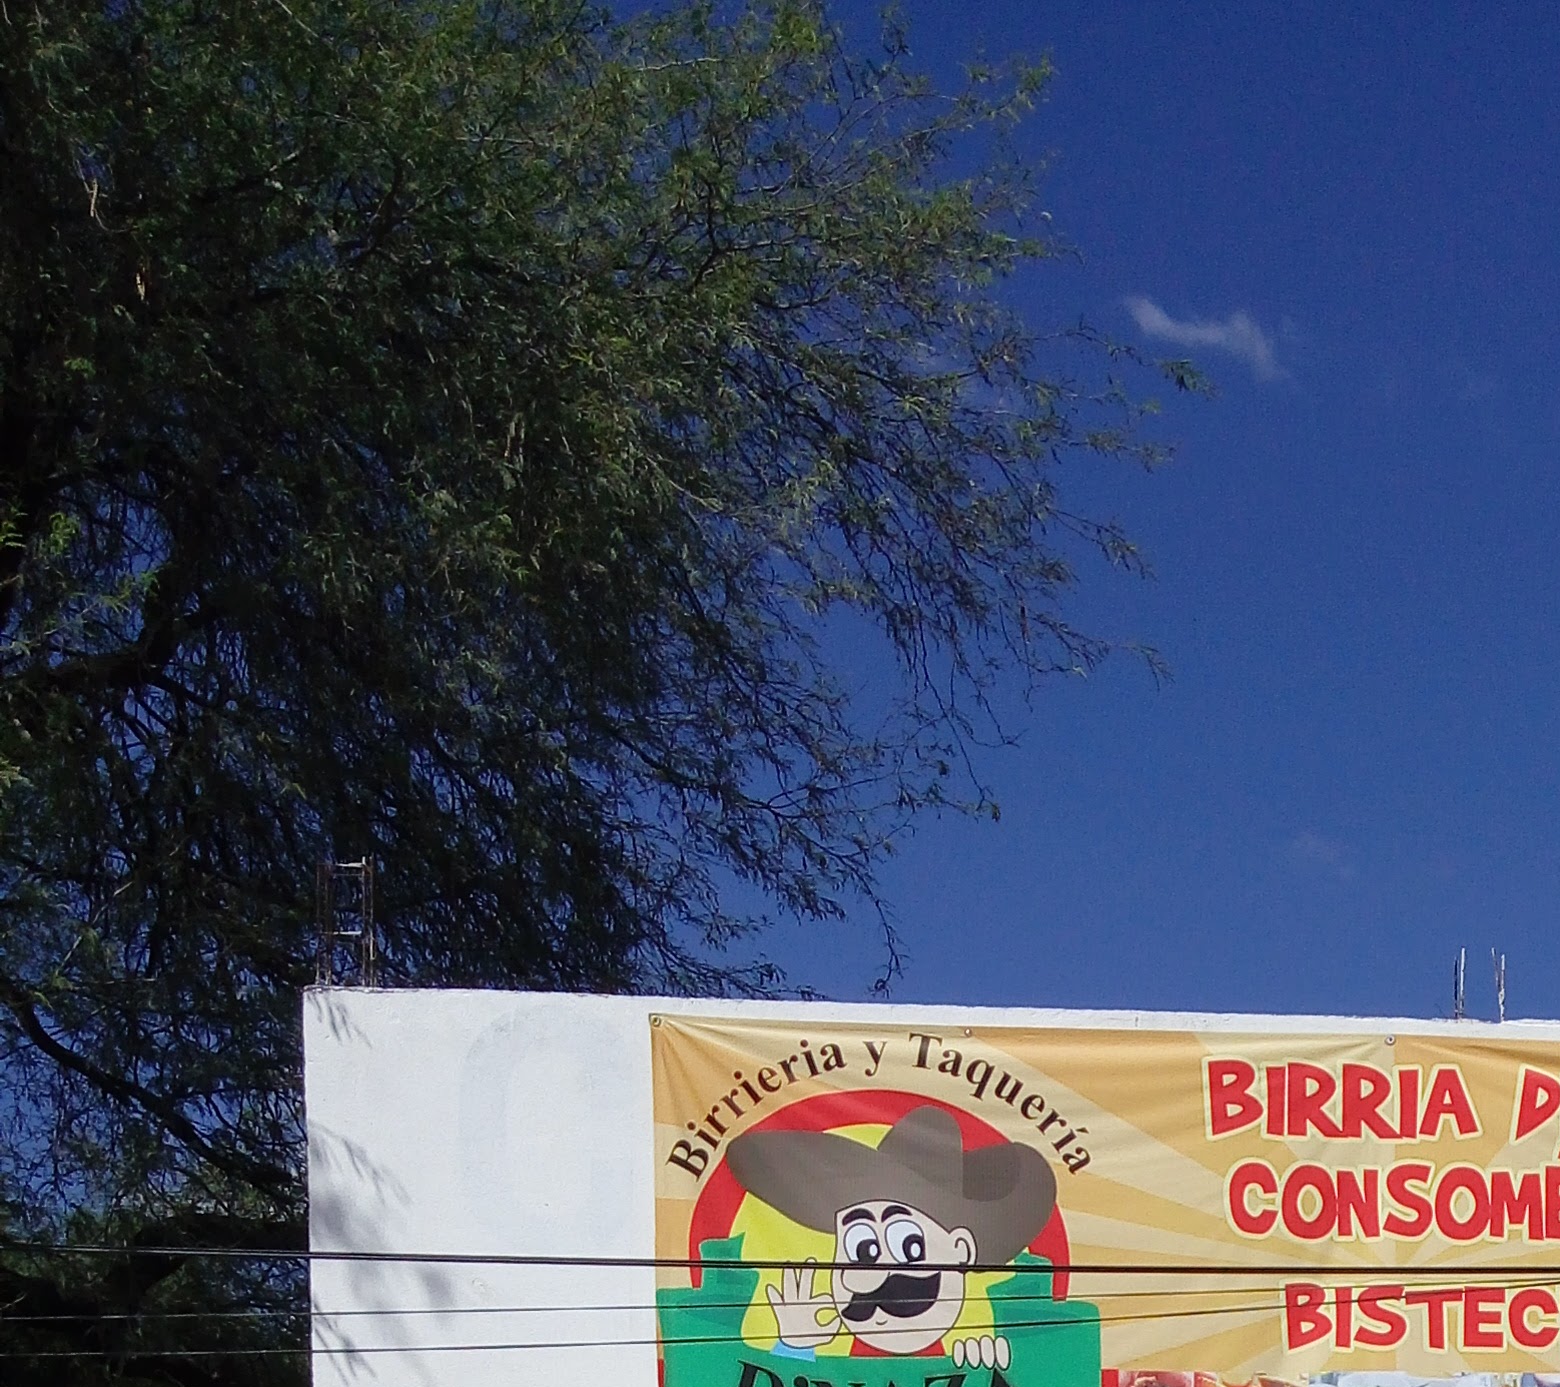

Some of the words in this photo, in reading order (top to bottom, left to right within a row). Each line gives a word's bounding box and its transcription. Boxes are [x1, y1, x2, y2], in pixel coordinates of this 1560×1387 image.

[863, 1039, 888, 1077] y
[908, 1032, 1092, 1176] Taquería
[1206, 1058, 1480, 1141] BIRRIA
